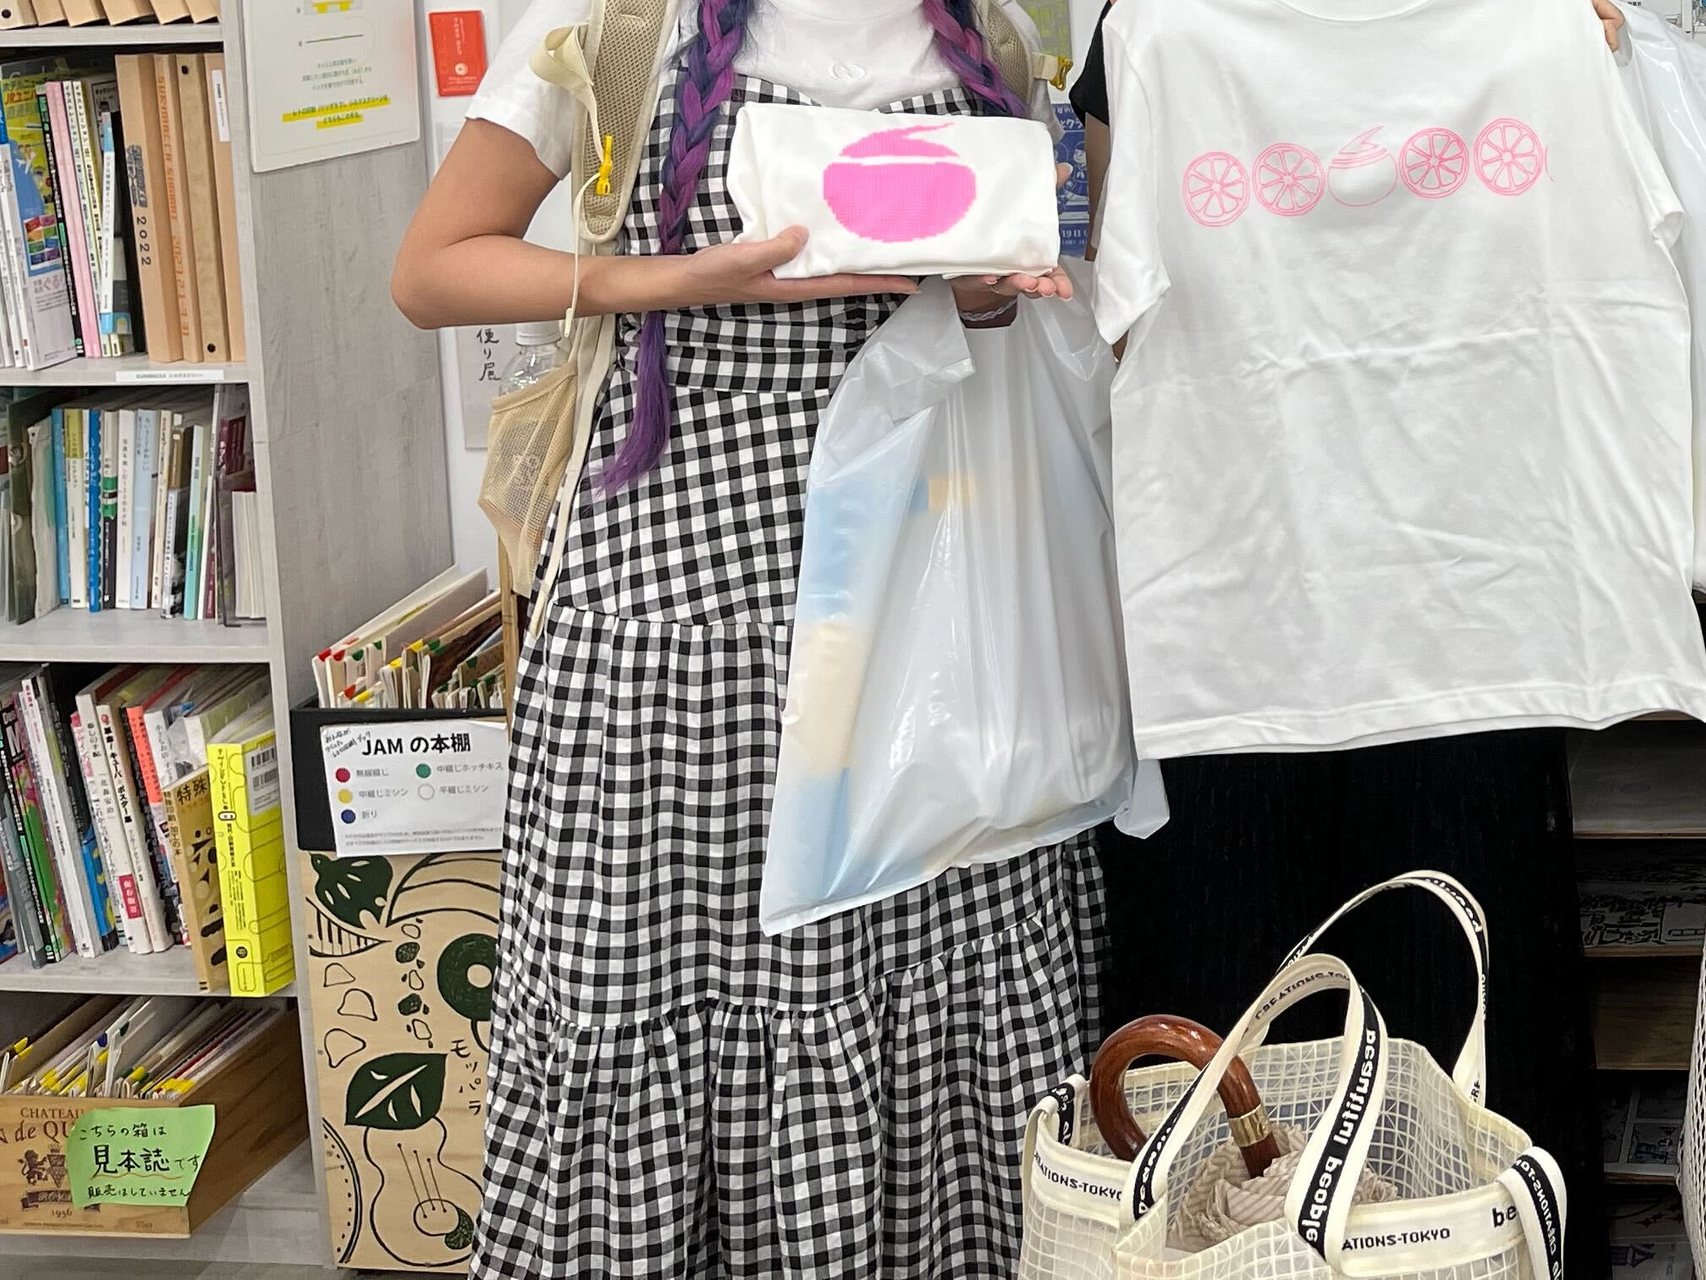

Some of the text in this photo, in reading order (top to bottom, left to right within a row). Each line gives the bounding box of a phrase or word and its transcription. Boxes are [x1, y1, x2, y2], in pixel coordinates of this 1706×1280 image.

[136, 215, 152, 267] 2022
[361, 733, 472, 757] JAM の本棚
[358, 786, 409, 799] 中綴じミシン
[450, 1038, 484, 1117] モッパラ
[78, 1122, 167, 1141] こちらの箱は
[92, 1143, 201, 1178] 見本誌です
[87, 1185, 191, 1200] 販売はしていません
